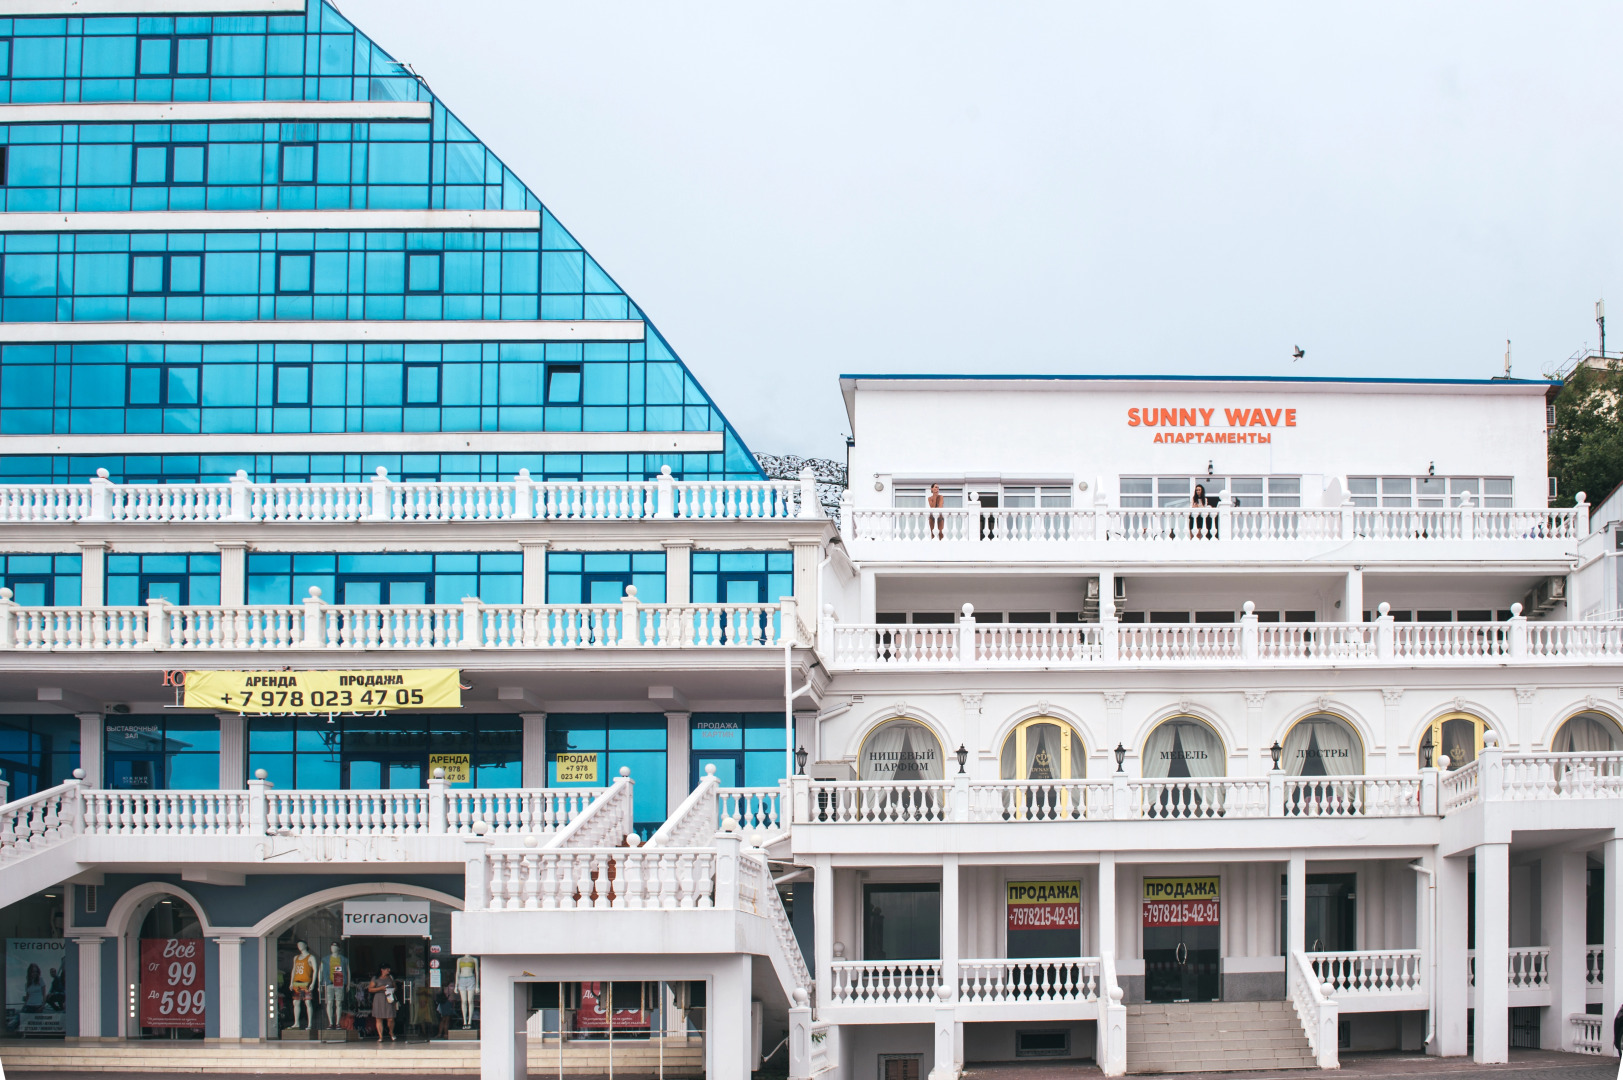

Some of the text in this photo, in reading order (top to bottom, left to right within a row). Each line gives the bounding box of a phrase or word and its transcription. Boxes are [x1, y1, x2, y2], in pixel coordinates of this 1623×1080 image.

[1127, 407, 1297, 427] SUNNY WAVE
[1153, 432, 1271, 444] АПАРТАМЕНТЫ
[245, 675, 404, 688] АРЕНДА ПРОДАЖА
[261, 691, 304, 707] 978
[310, 690, 353, 707] 023
[360, 689, 388, 705] 47
[395, 689, 424, 705] 05
[697, 722, 739, 730] ПРОДАЖА
[869, 748, 935, 760] НИШЕВЫЙ
[1160, 750, 1208, 760] МЕБЕЛЬ
[1296, 748, 1349, 758] ЛЮСТРЫ
[430, 755, 469, 764] АРЕНДА
[557, 755, 597, 764] ПРОДАМ
[874, 762, 929, 772] ПАРФЮМ
[1009, 885, 1079, 902] ПРОДАЖА
[1146, 882, 1217, 899] ПРОДАЖА
[163, 938, 196, 958] Всё
[167, 961, 197, 986] 99
[159, 989, 205, 1015] 599
